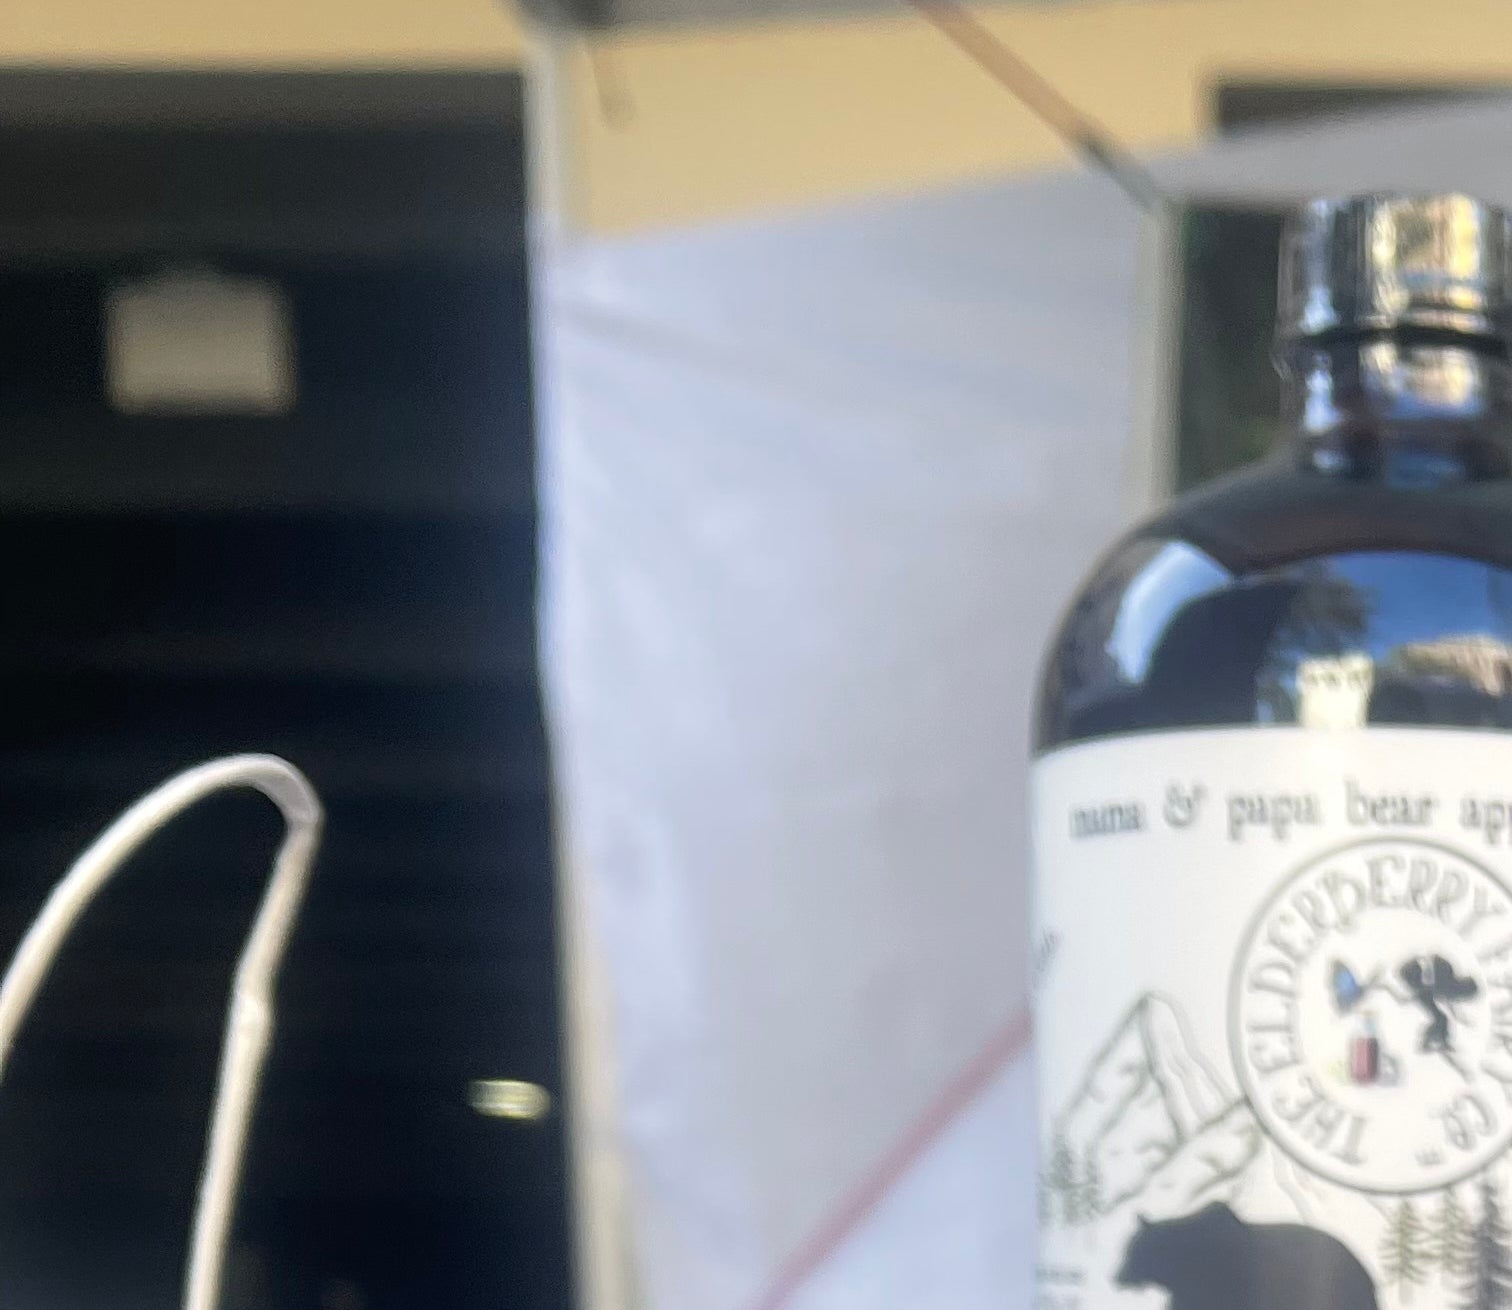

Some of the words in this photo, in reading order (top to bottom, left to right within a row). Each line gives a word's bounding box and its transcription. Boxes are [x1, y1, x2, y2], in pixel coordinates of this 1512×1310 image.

[1162, 784, 1206, 830] &
[1226, 792, 1322, 842] papa
[1344, 781, 1434, 827] bear
[1246, 854, 1510, 1078] ELDERBERRY
